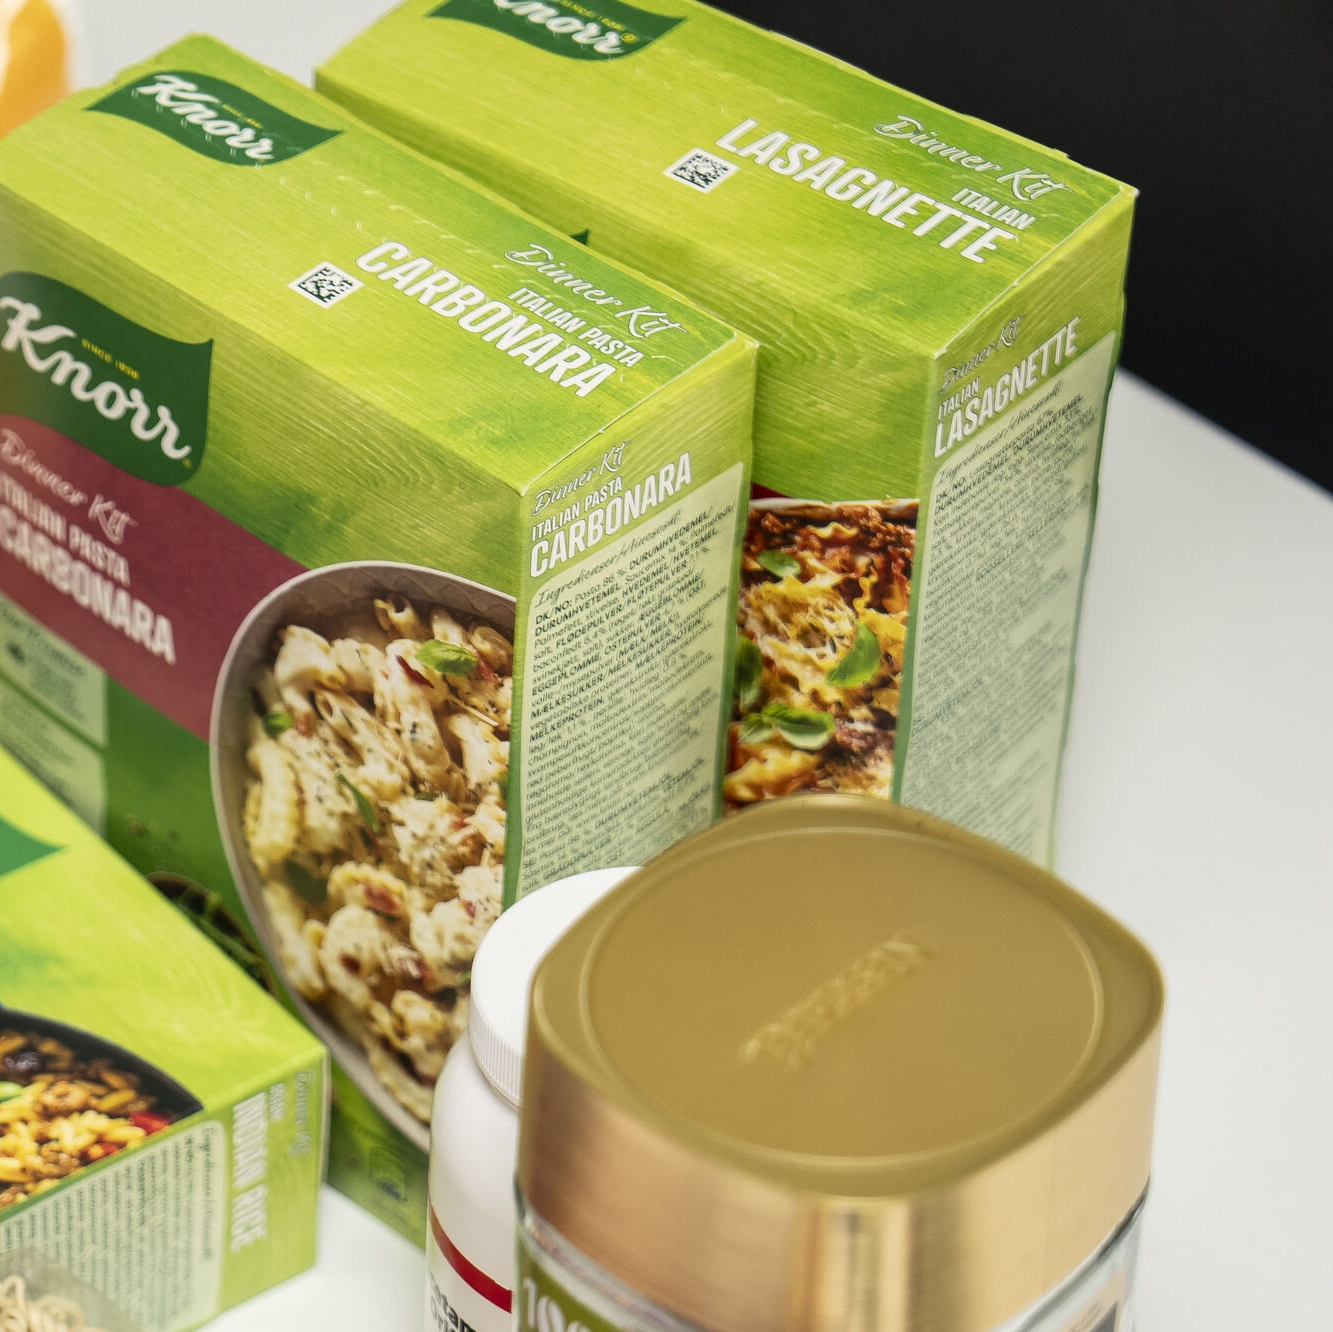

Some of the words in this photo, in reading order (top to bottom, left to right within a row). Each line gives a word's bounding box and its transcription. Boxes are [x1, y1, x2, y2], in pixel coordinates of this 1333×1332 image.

[493, 0, 624, 54] norr
[136, 74, 275, 161] Knorr
[715, 118, 1019, 264] LASAGNETTE
[873, 114, 986, 180] Dinner
[995, 162, 1075, 202] Kit
[951, 186, 1036, 231] ITALIAN
[356, 241, 617, 399] CARBONARA
[504, 243, 616, 308] Dinner
[623, 295, 690, 340] Kit
[508, 287, 583, 338] ITALIAN
[582, 322, 644, 369] PASTA
[934, 315, 1081, 458] LASAGNETTE
[938, 377, 980, 420] ITALIAN
[939, 342, 996, 394] Dinner
[530, 451, 692, 578] CARBONARA
[532, 467, 597, 515] Dinner
[600, 440, 631, 475] Kit
[533, 502, 580, 541] ITALIAN
[585, 476, 623, 512] PASTA
[69, 524, 131, 587] PASTA
[88, 494, 137, 544] Kit
[231, 1186, 267, 1254] RICE
